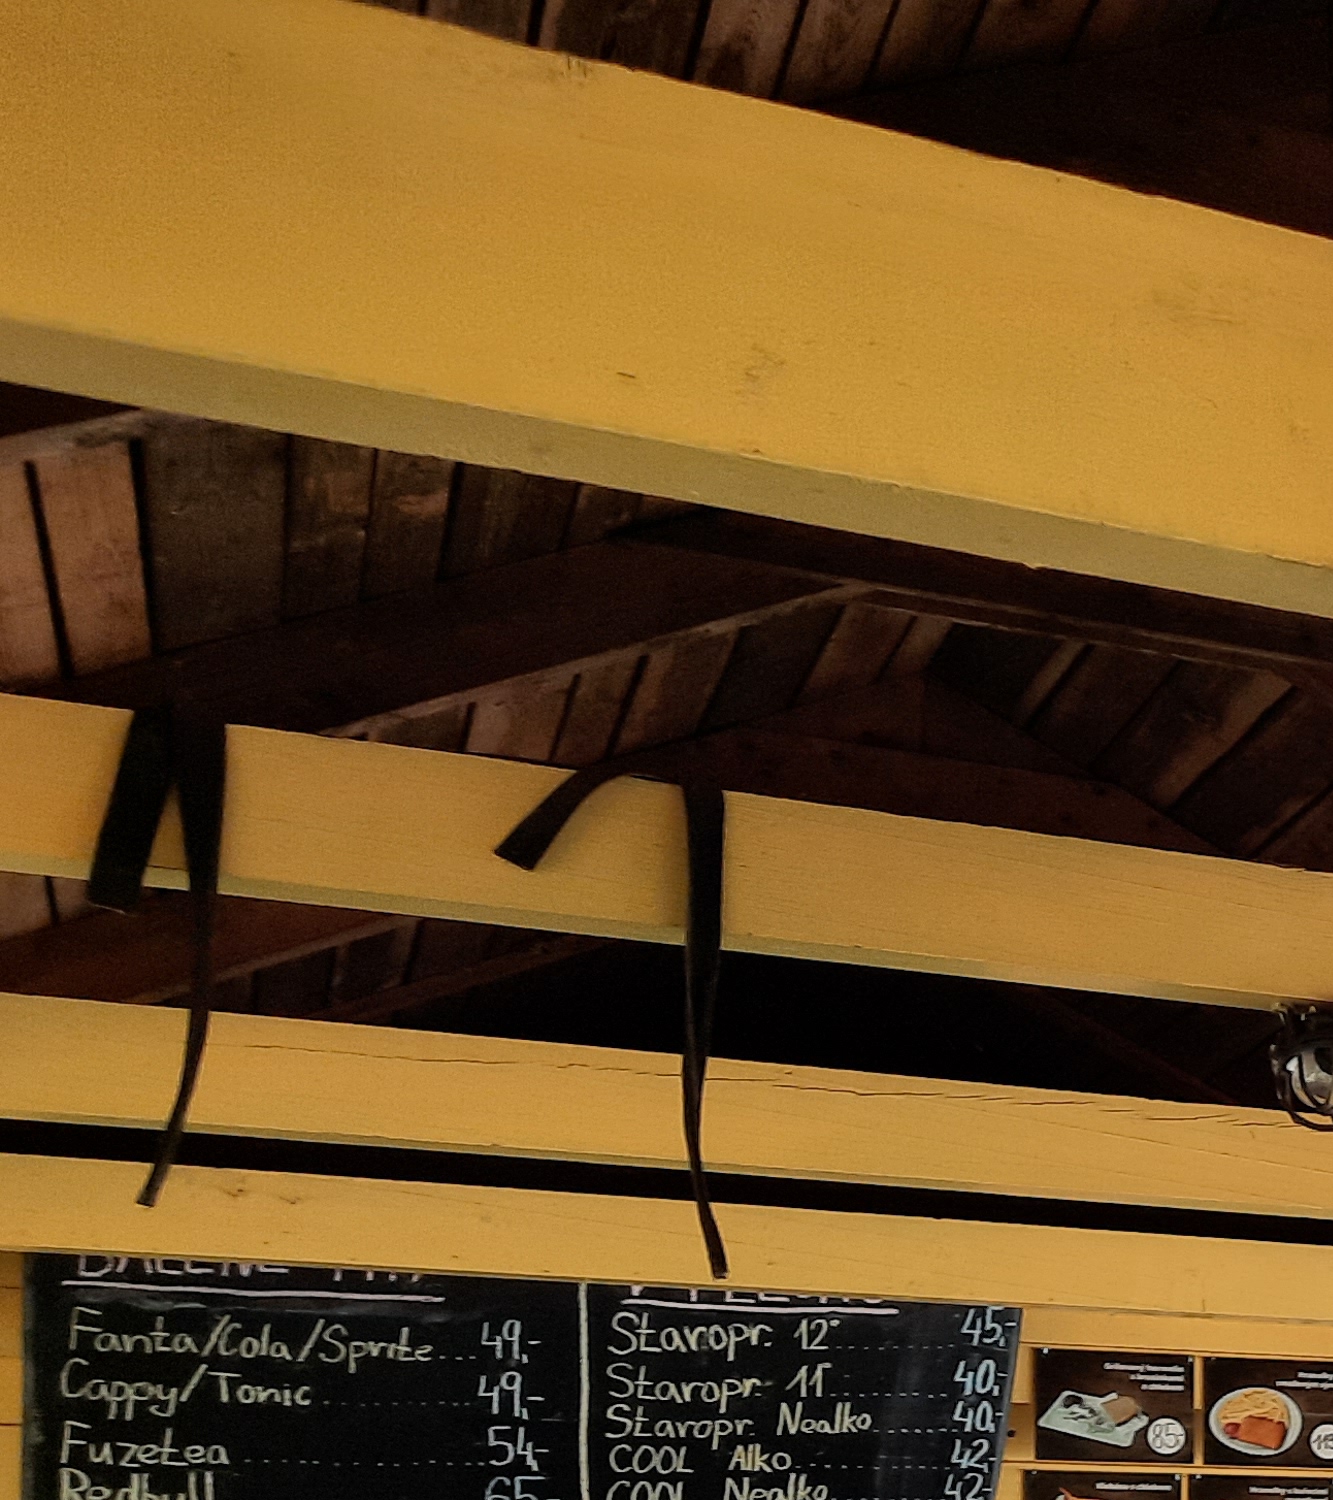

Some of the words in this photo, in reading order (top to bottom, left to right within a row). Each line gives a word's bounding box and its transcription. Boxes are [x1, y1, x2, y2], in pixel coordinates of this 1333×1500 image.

[776, 1401, 873, 1436] Nealko
[59, 1420, 230, 1468] Fuzetea
[608, 1444, 695, 1475] COOL
[727, 1443, 793, 1473] Alko
